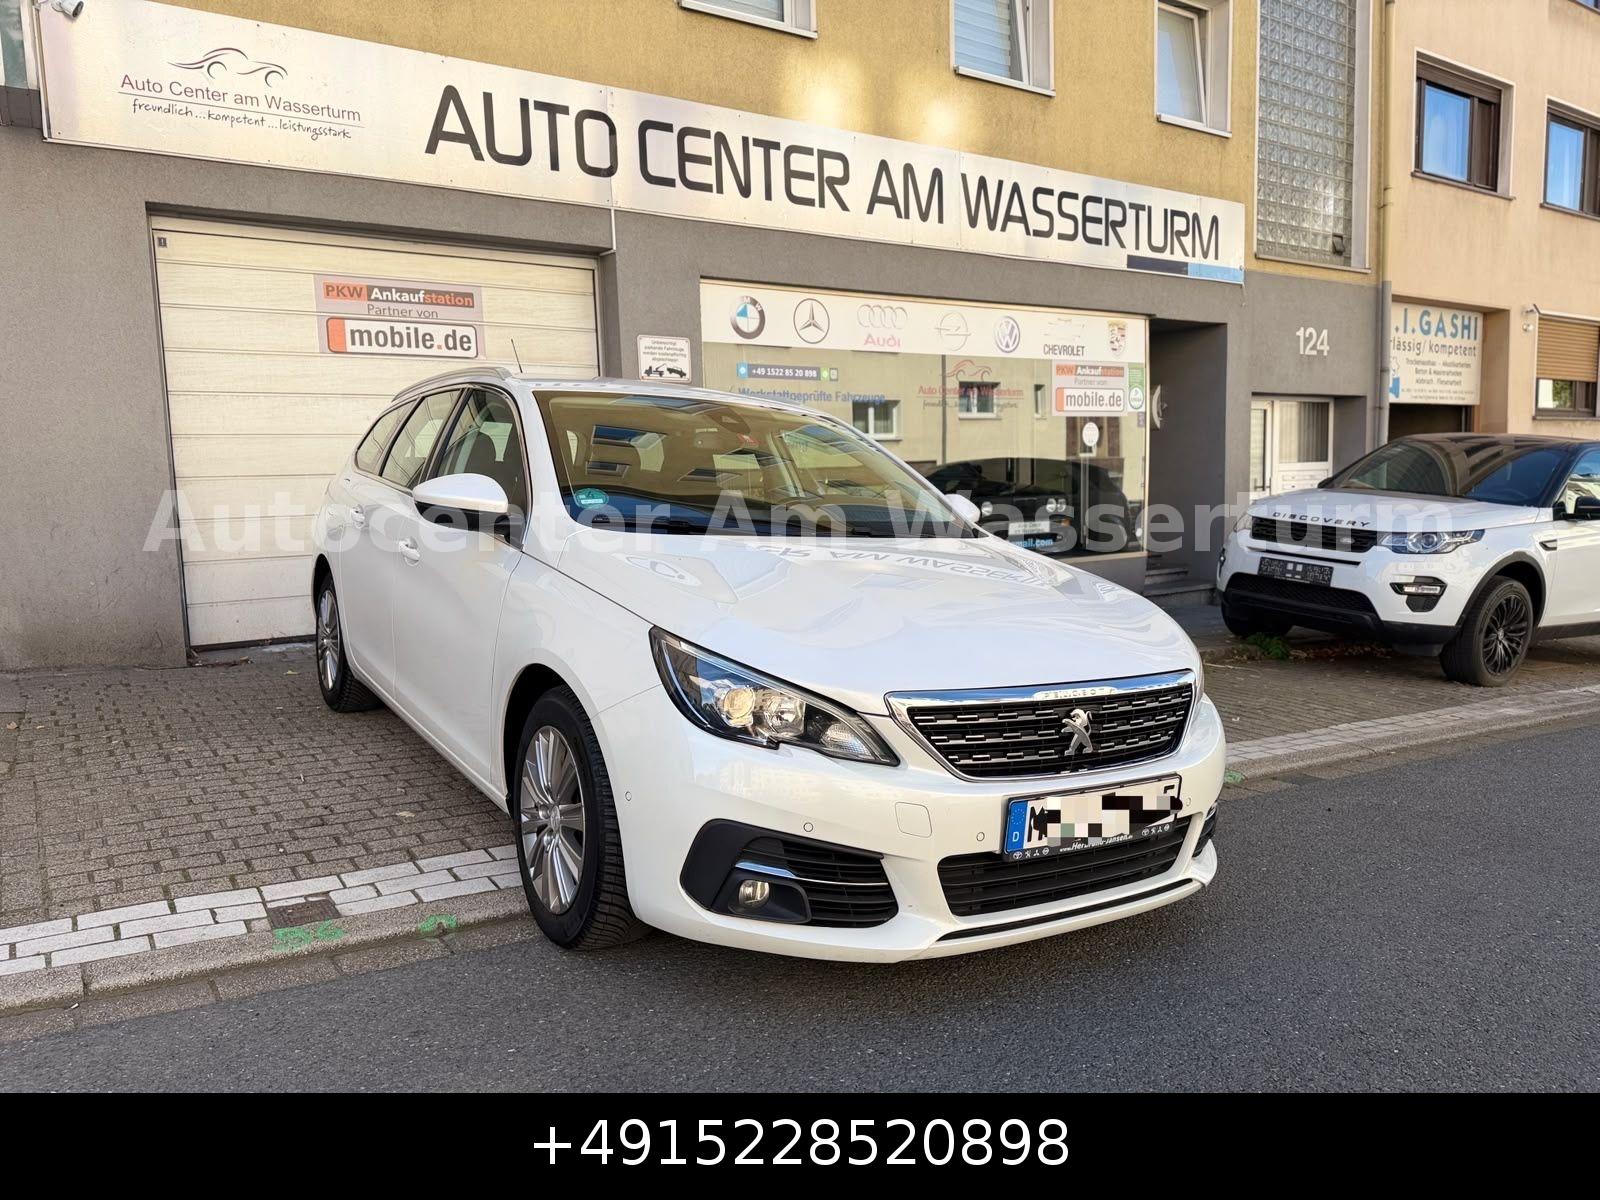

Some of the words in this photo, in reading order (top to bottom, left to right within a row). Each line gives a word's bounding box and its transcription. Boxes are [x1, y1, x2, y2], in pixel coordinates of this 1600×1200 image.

[120, 74, 163, 93] Auto
[169, 81, 228, 103] Center
[234, 93, 260, 107] am
[265, 94, 361, 122] Wasserturm
[425, 84, 619, 178] AUTO
[638, 119, 850, 212] CENTER
[866, 158, 944, 224] AM
[960, 172, 1219, 261] WASSERTURM
[325, 284, 363, 298] PKW
[371, 286, 473, 307] Ankaufstation
[367, 303, 413, 318] Partner
[416, 309, 439, 318] von
[1395, 308, 1478, 341] .I.GASHI
[350, 325, 472, 351] mobile.de
[863, 333, 902, 348] Audi
[1295, 326, 1330, 356] 124
[1043, 343, 1085, 357] CHEVROLET
[1428, 340, 1476, 357] kompetent
[767, 368, 784, 376] 1522
[784, 368, 794, 377] 85
[794, 368, 804, 377] 20
[804, 369, 818, 378] 898
[835, 390, 886, 404] Fahrzeuge
[1066, 391, 1122, 407] mobile.de
[1272, 511, 1371, 528] DISCOVERY
[1014, 537, 1054, 548] mail.com
[1012, 831, 1019, 842] D
